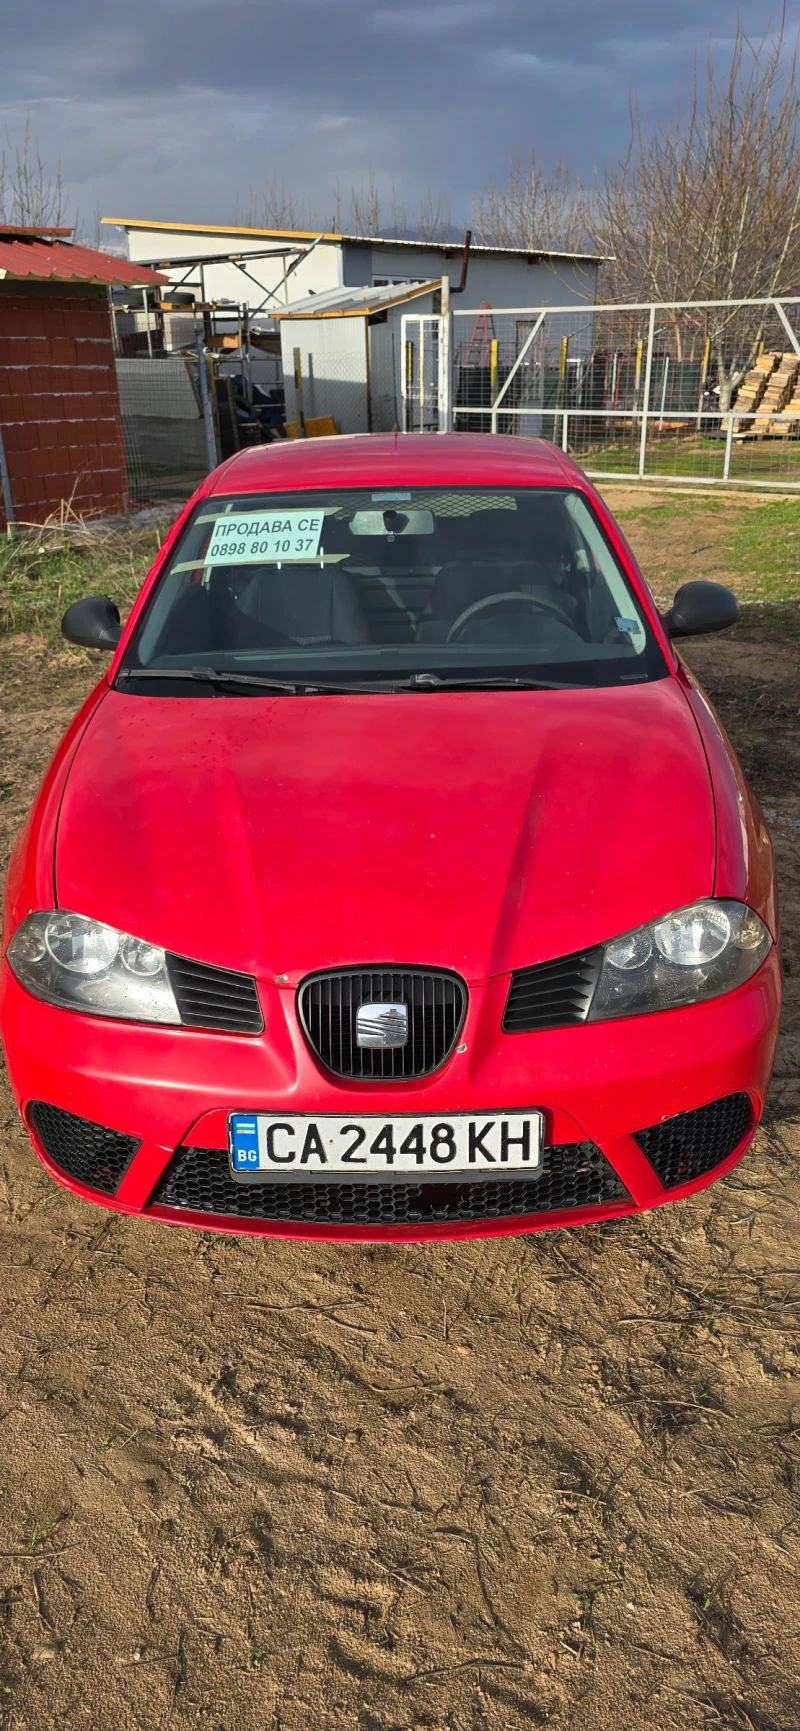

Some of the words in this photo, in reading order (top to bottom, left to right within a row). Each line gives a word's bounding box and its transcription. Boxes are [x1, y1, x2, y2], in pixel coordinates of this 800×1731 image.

[215, 520, 292, 537] ПРОДАВА
[298, 518, 320, 531] СЕ
[211, 543, 246, 557] 0898
[250, 541, 268, 553] 80
[274, 539, 291, 552] 10
[295, 539, 313, 551] 37
[339, 1122, 457, 1165] 2448
[237, 1149, 257, 1162] BG
